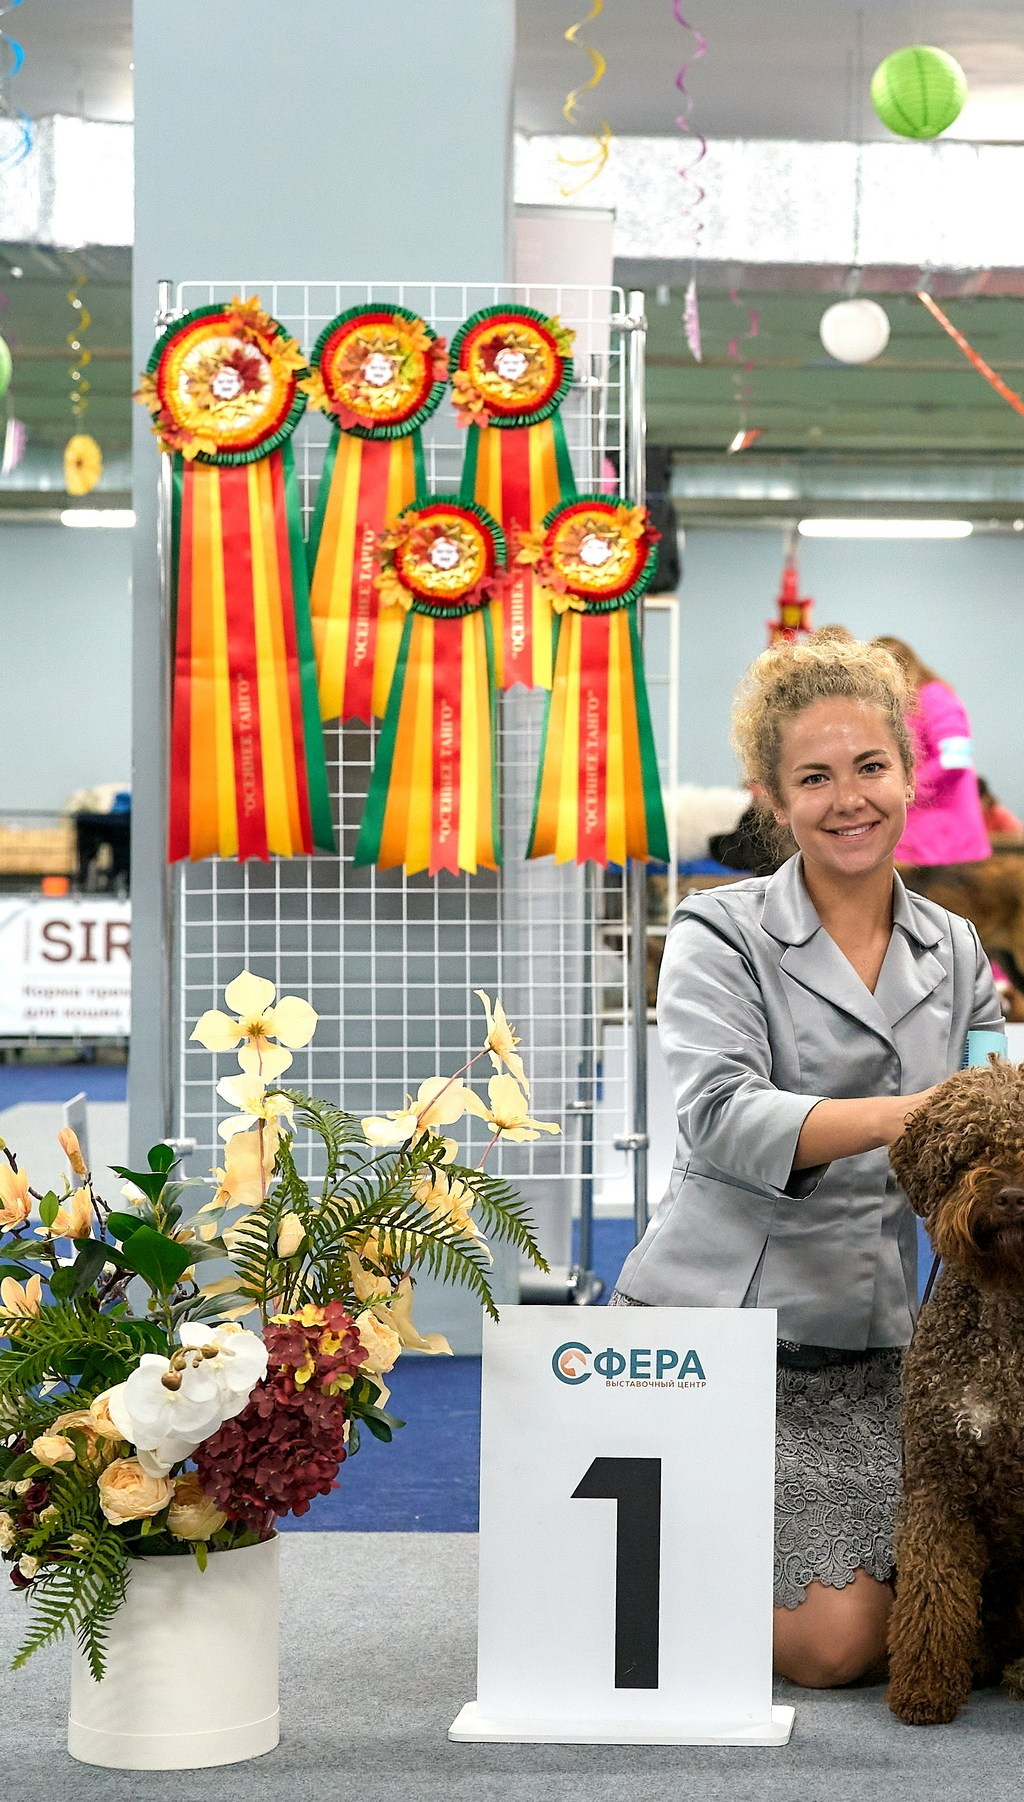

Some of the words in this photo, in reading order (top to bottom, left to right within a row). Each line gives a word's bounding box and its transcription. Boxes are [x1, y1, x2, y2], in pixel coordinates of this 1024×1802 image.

[439, 763, 453, 843] "ОСЕННЕЕ
[585, 752, 599, 835] "ОСЕННЕЕ
[552, 1341, 707, 1386] СФЕРА
[605, 1380, 675, 1388] ВЫСТАВОЧНЫЙ
[677, 1381, 707, 1389] ЦЕНТР
[570, 1457, 662, 1690] 1
